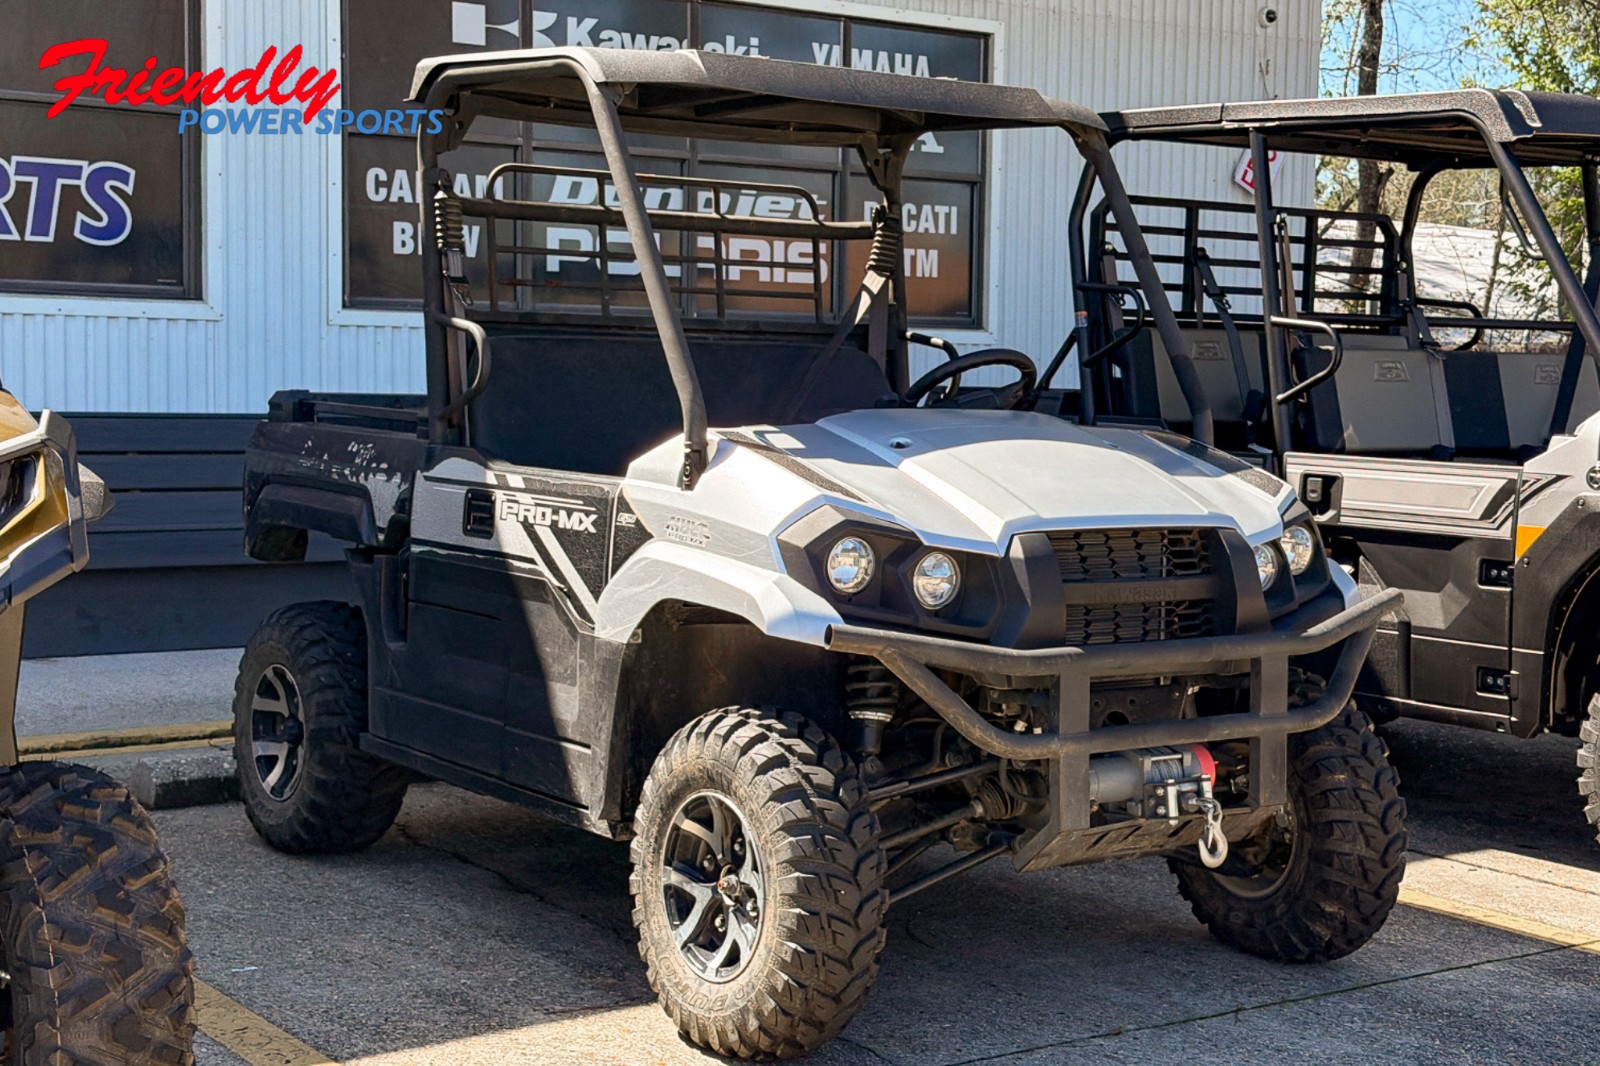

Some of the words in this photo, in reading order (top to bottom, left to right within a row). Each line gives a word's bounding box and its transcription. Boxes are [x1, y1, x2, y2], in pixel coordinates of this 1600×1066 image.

[566, 16, 760, 57] Kawaki
[366, 167, 504, 203] CAAM
[863, 200, 958, 235] DCATI
[393, 221, 481, 258] BW
[501, 500, 599, 533] PRO-MX
